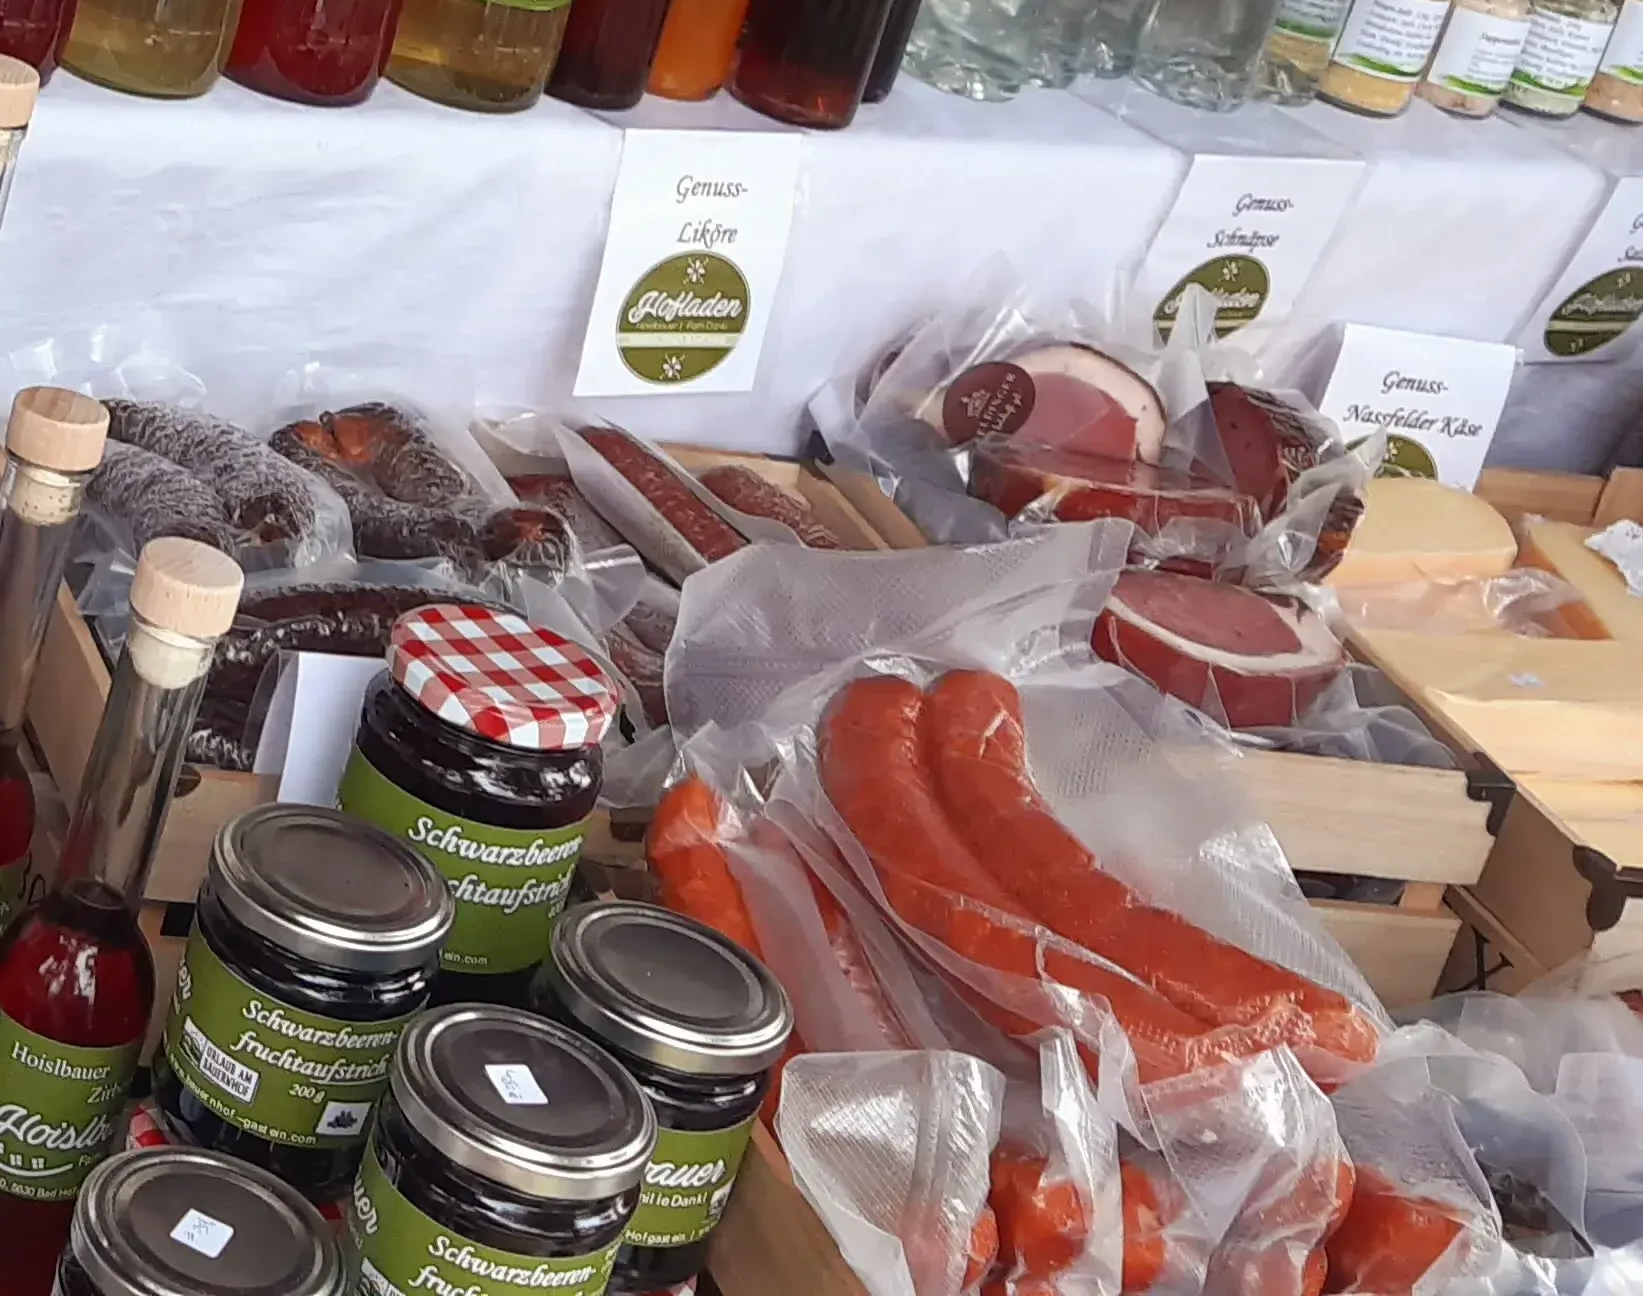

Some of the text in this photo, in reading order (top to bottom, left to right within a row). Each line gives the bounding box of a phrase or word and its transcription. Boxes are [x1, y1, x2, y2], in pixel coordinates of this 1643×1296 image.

[675, 174, 749, 204] Genuss-
[676, 217, 739, 249] Liköre
[627, 289, 743, 325] Hofladen
[1380, 369, 1449, 395] Genuss-
[1342, 402, 1484, 439] Nassfelder Käse
[10, 1039, 111, 1081] Hoislbauer
[205, 1045, 254, 1084] URLAUB AM
[229, 1030, 392, 1083] fruchtaufstrich
[202, 1061, 251, 1099] BAUERNHOF
